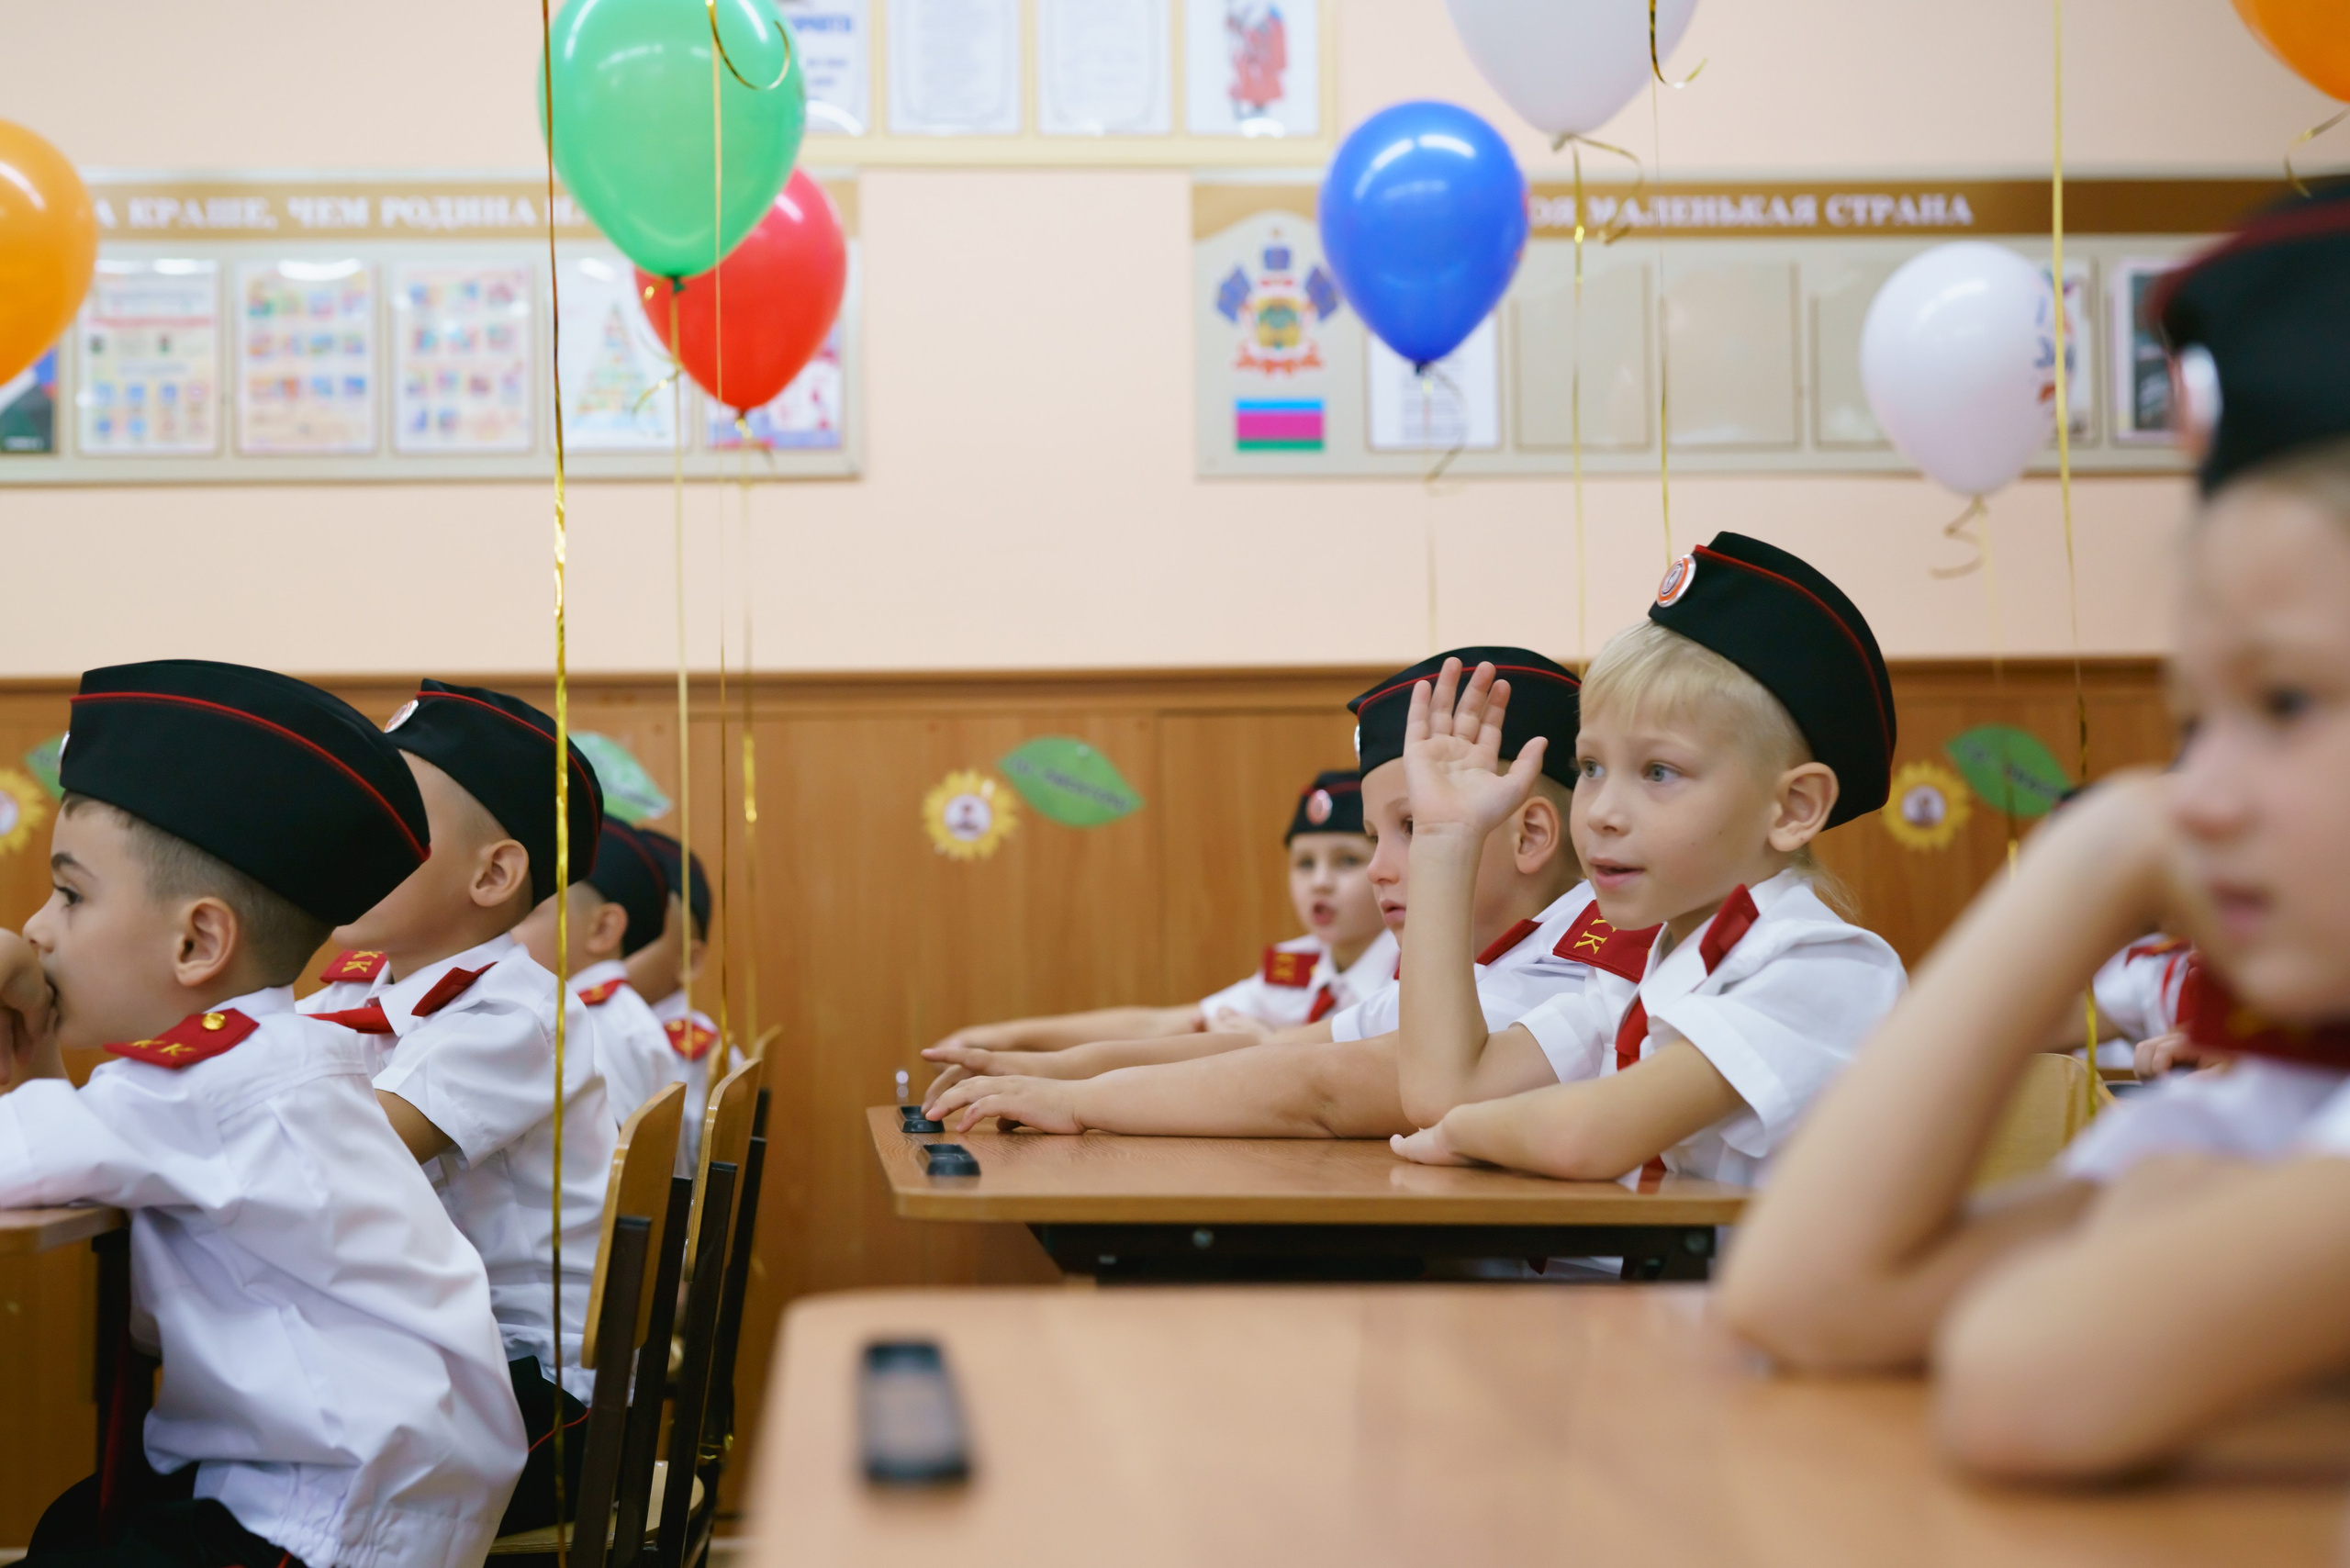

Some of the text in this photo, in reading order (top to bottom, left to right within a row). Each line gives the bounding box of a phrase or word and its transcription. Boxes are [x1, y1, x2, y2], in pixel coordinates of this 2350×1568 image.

[286, 196, 370, 229] ЧЕМ
[379, 195, 539, 232] РОДИНА
[1528, 192, 1975, 228] ОЯ МАЛЕНЬКАЯ СТРАНА
